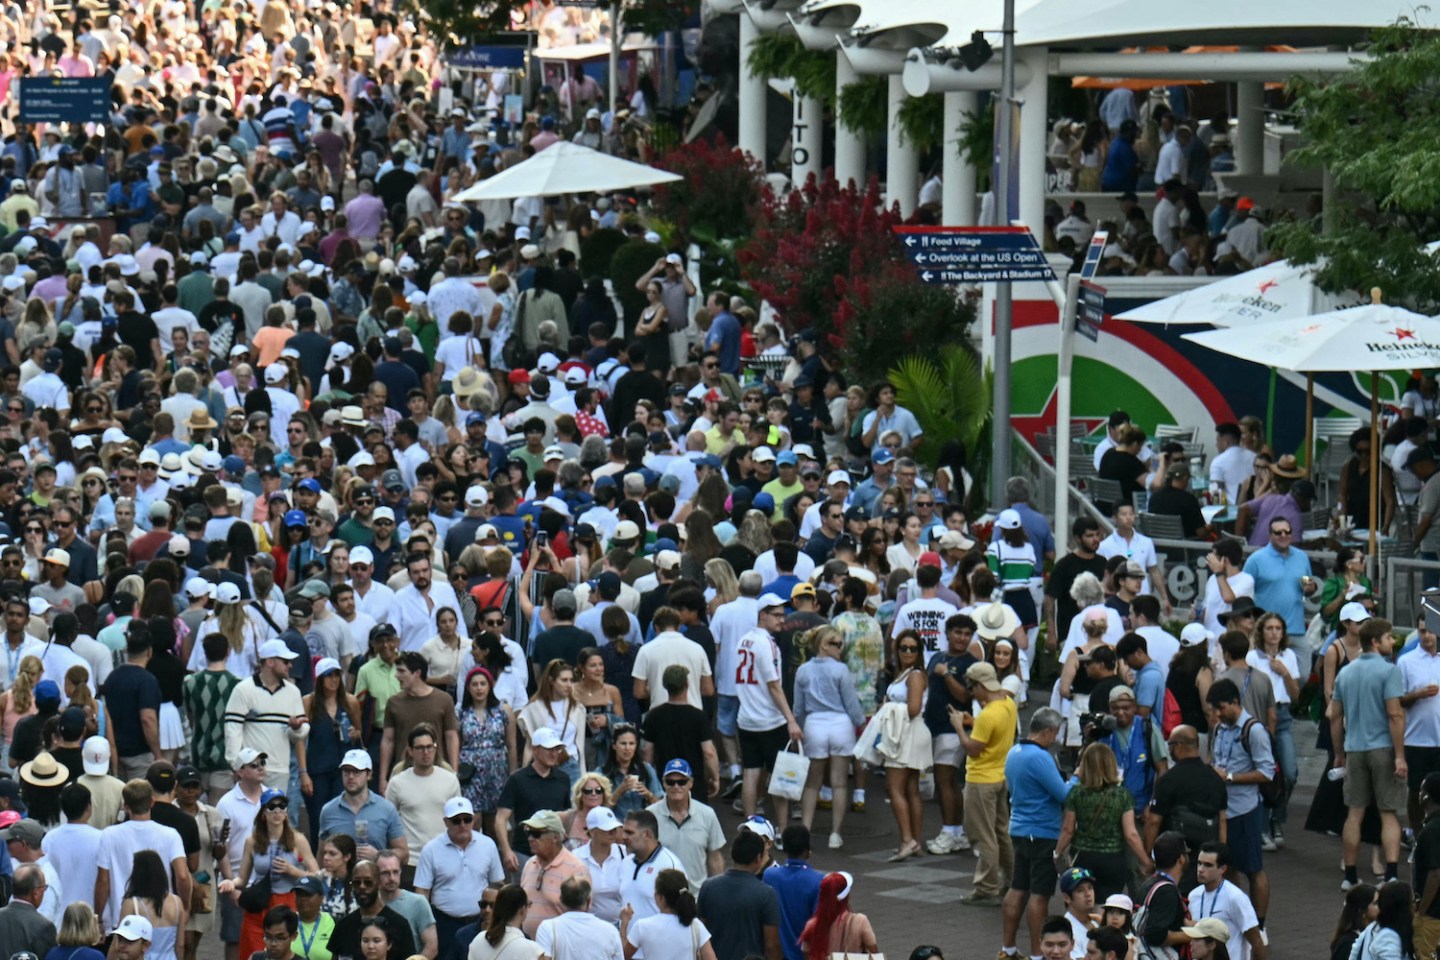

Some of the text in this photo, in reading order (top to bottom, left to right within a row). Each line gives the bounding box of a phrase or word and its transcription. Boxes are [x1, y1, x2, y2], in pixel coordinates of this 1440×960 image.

[930, 237, 982, 247] Food Village
[929, 253, 1038, 264] Overlook at the US Open
[948, 271, 963, 280] The
[963, 271, 1001, 280] Backyard
[1002, 271, 1008, 280] &
[1009, 270, 1041, 279] Stadium
[907, 610, 945, 620] WINNING
[913, 620, 939, 628] IS FOR
